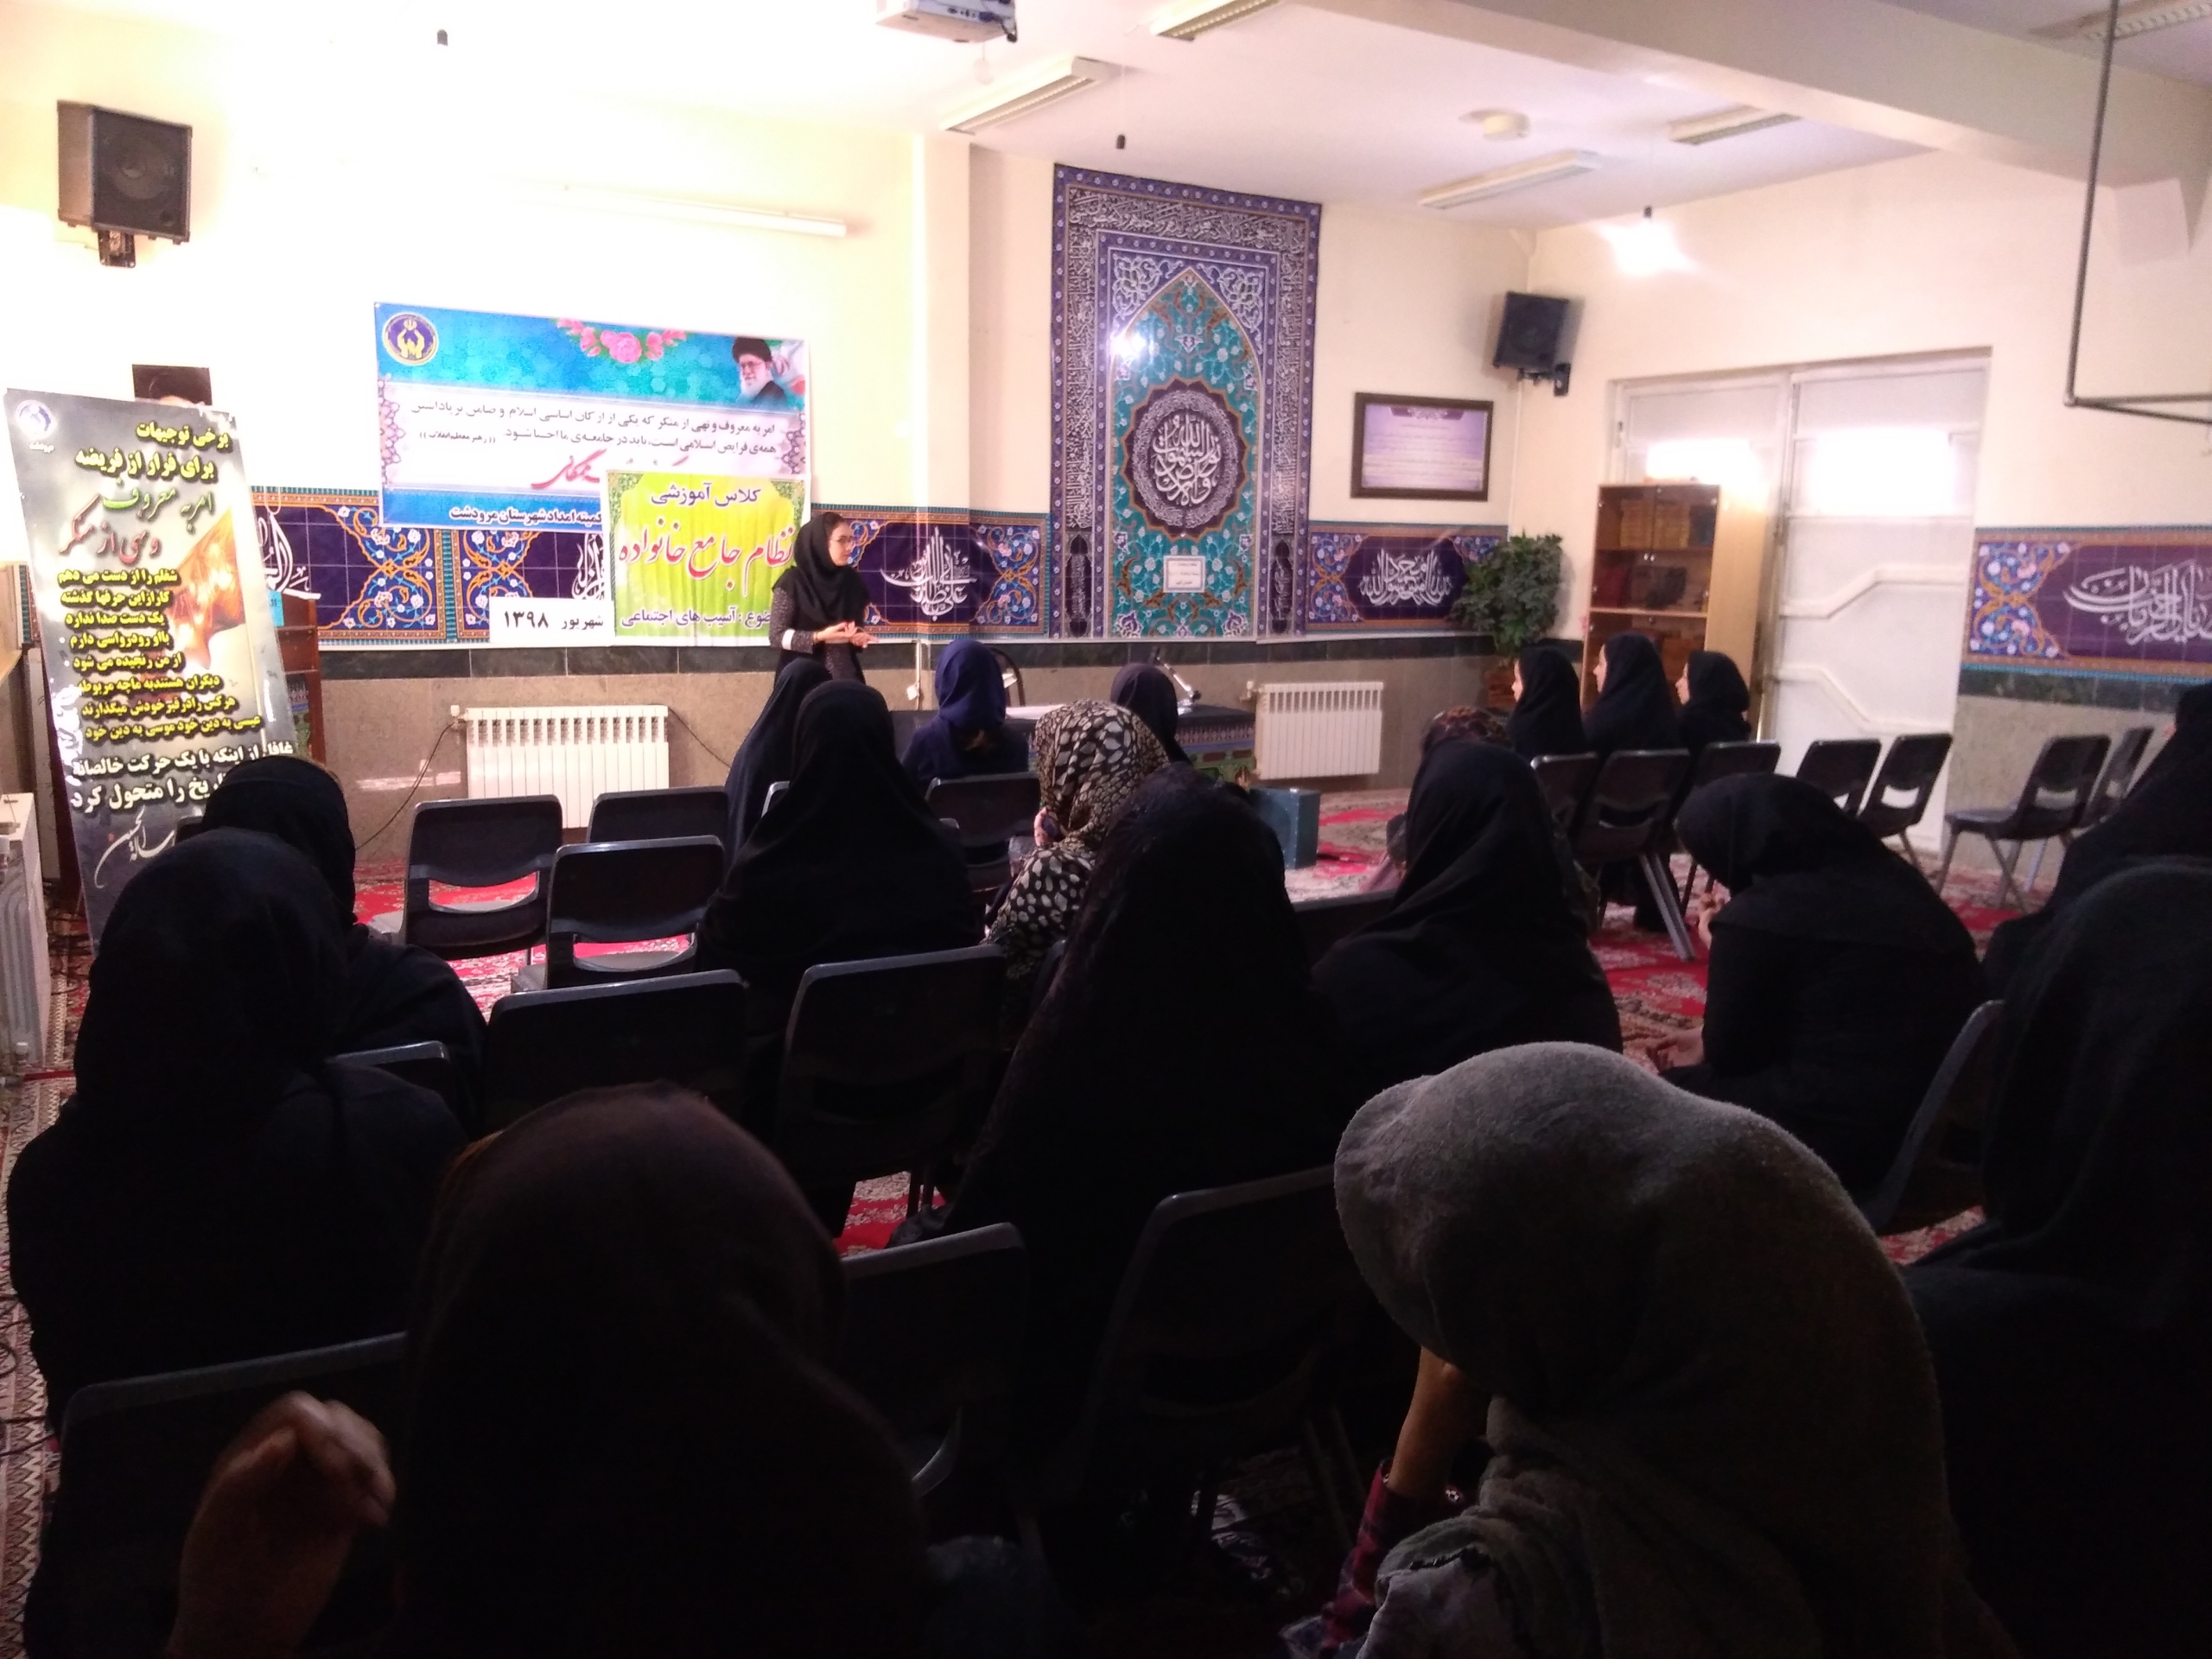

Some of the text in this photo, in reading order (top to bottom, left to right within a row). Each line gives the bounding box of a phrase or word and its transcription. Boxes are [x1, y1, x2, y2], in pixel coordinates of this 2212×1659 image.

[510, 406, 537, 419] اسلام
[539, 410, 572, 422] اساسی
[607, 413, 615, 424] از
[641, 415, 655, 425] که
[618, 414, 639, 428] یکی
[658, 416, 679, 429] منکر
[682, 418, 690, 429] از
[691, 419, 709, 432] نهی
[719, 423, 750, 434] معروف
[753, 424, 760, 433] به
[137, 421, 230, 448] برخی توجیهات
[763, 424, 775, 437] امر
[617, 435, 628, 445] در
[680, 440, 715, 452] اسلامی
[75, 448, 214, 480] برای فرار از فریضه
[652, 482, 760, 506] کلاس آموزشی
[450, 507, 497, 523] مرودشت
[499, 508, 546, 524] شهرستان
[549, 511, 574, 523] امداد
[98, 521, 116, 554] از
[150, 538, 161, 556] و
[619, 518, 794, 597] نظام جامع خانواده
[58, 569, 80, 585] دهم
[82, 571, 100, 585] می
[101, 569, 128, 582] دست
[95, 589, 126, 607] حرفها
[96, 611, 118, 625] صدا
[120, 613, 145, 624] دست
[147, 611, 164, 626] یک
[505, 611, 604, 630] شهریور ۱۳۹۸
[621, 609, 672, 627] اجتماعی
[676, 612, 701, 626] های
[704, 607, 735, 626] آسیب
[745, 611, 771, 628] ضوع
[70, 632, 94, 648] دارم
[73, 652, 181, 671] از من رنجیده می شود
[130, 698, 165, 716] خودش
[86, 715, 261, 742] عیسی به دین خود موسی به دین خود
[127, 753, 171, 774] حرکت
[175, 750, 198, 770] یک
[198, 749, 210, 768] با
[213, 745, 245, 766] اینکه
[109, 783, 164, 810] متحول
[167, 777, 185, 803] را
[70, 785, 102, 813] کرد
